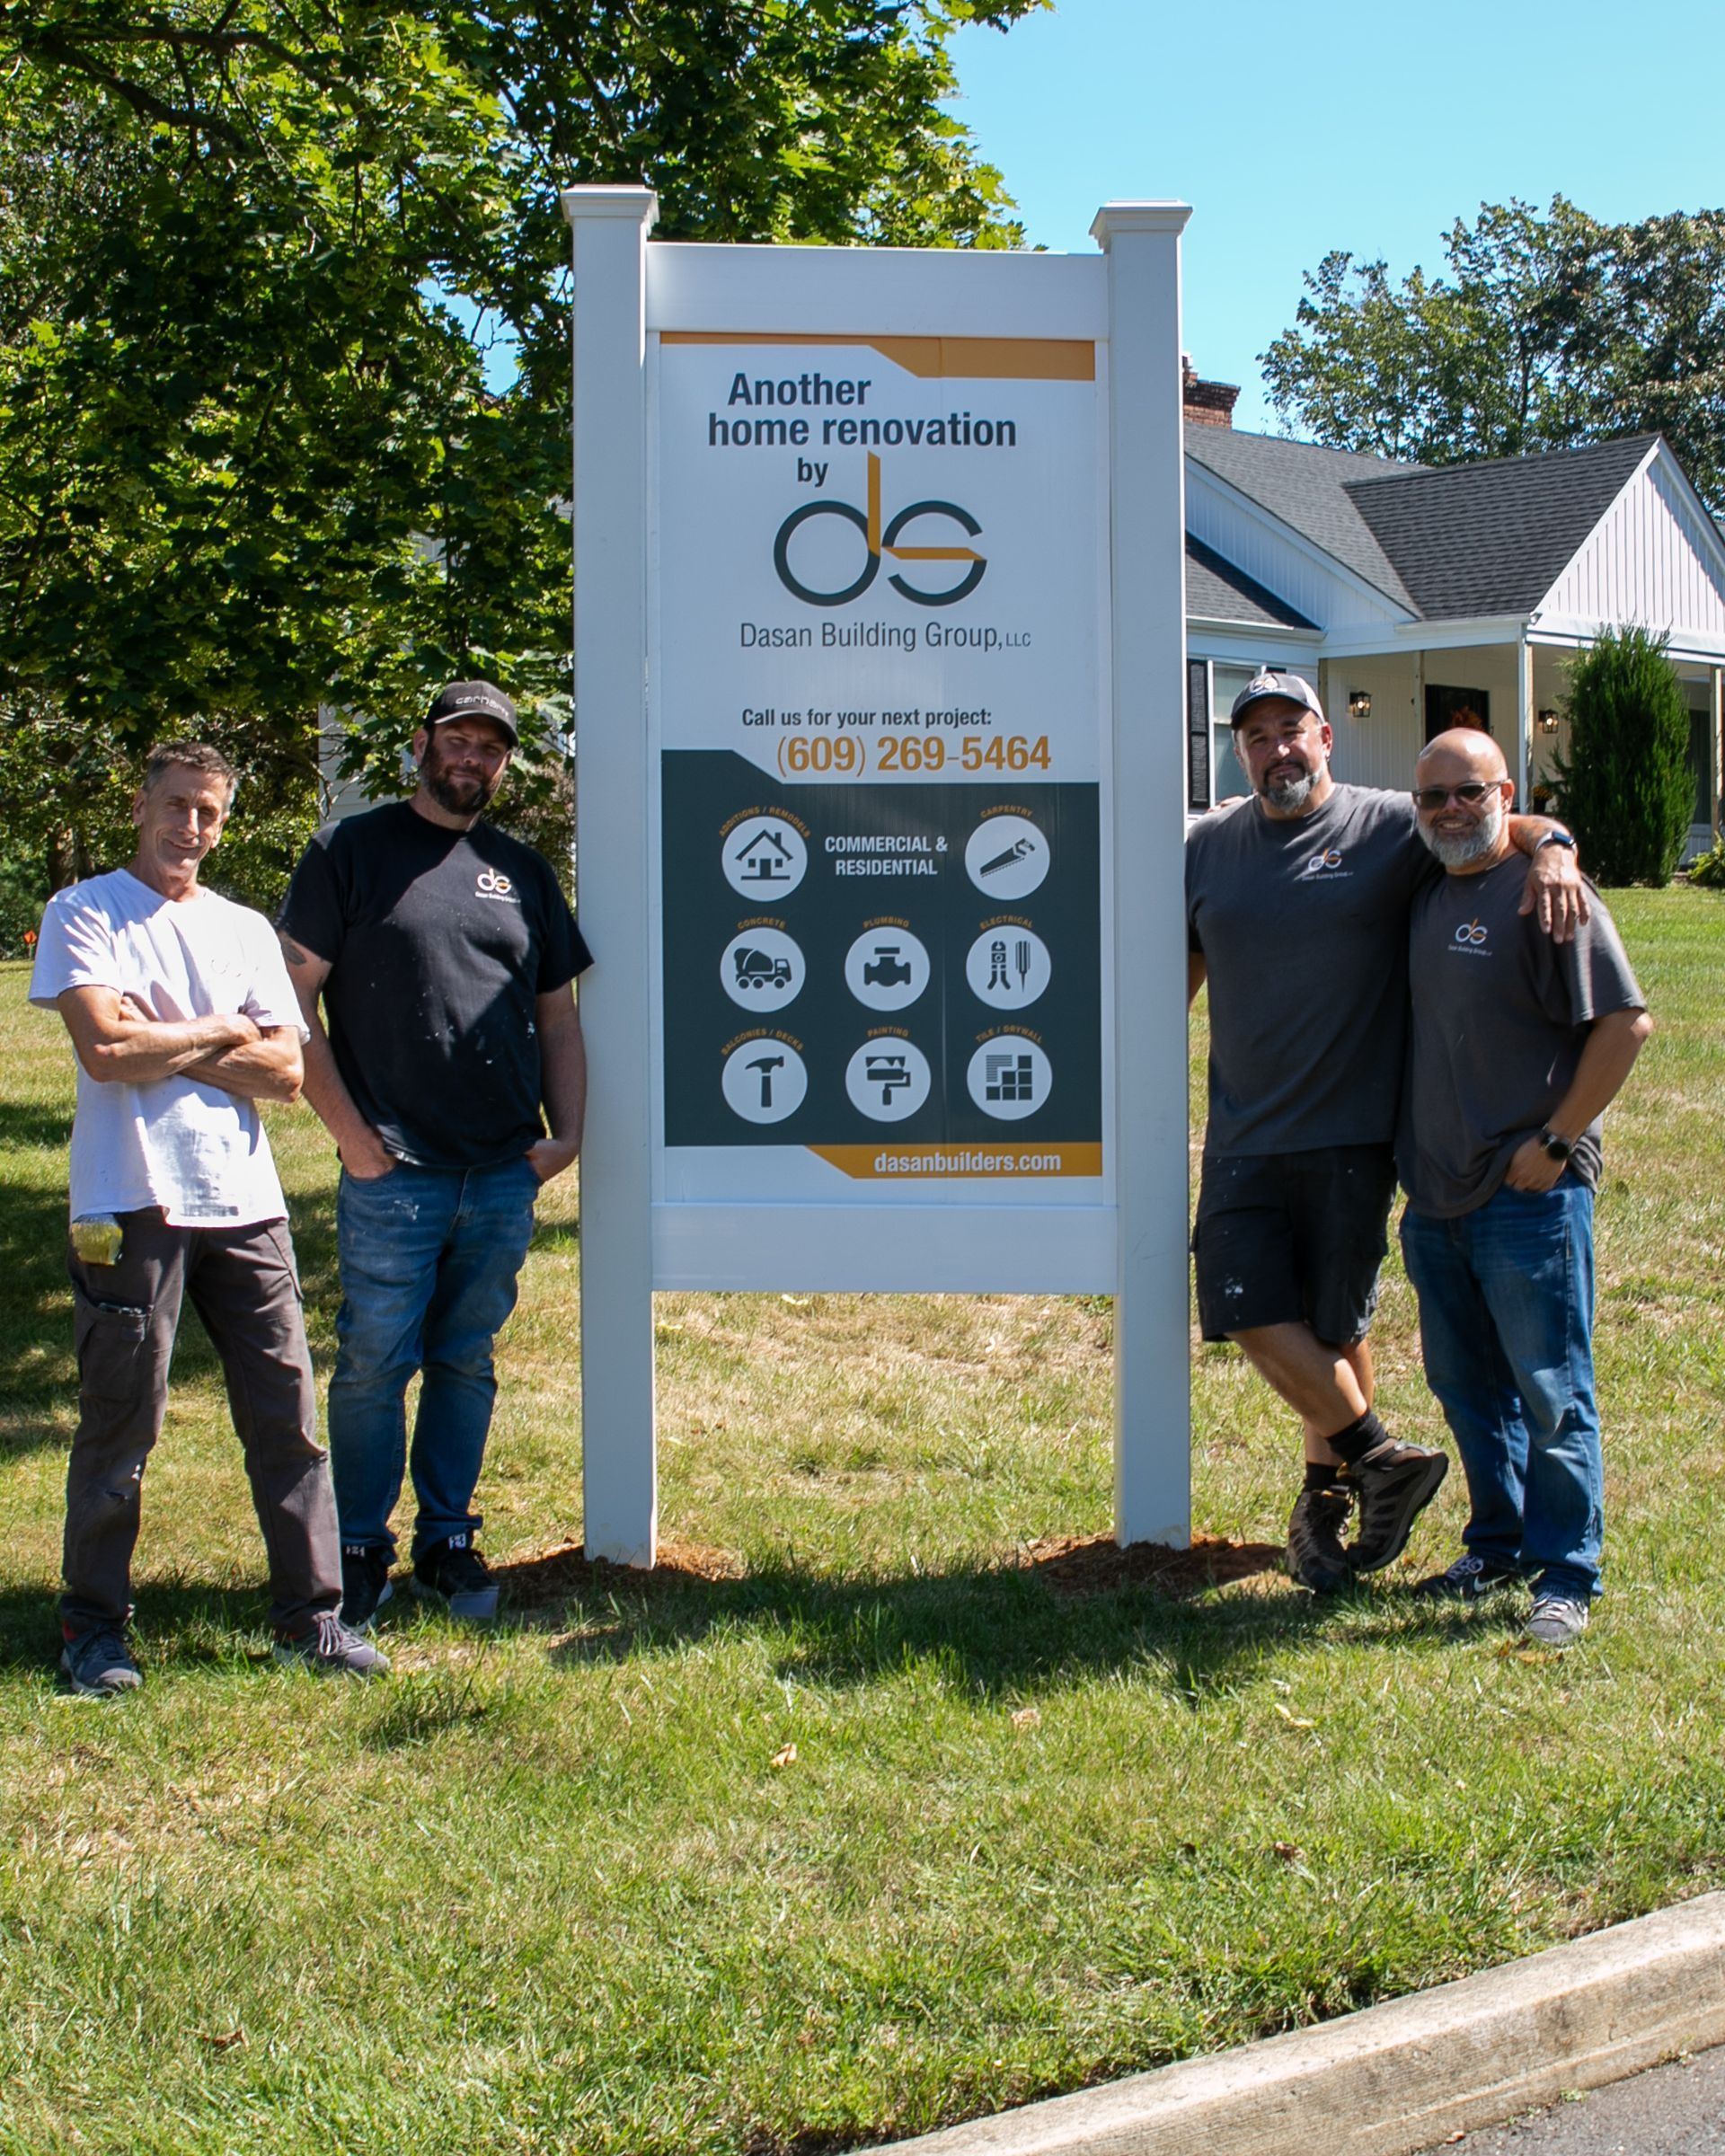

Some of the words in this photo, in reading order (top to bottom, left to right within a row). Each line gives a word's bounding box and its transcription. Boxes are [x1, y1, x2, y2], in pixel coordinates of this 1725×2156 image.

[728, 373, 871, 405] Another
[708, 412, 809, 446] home
[822, 411, 1017, 446] renovation
[797, 457, 828, 488] by
[740, 622, 812, 648] Dasan
[821, 622, 916, 652] Building
[741, 709, 775, 727] Call
[781, 711, 802, 726] us
[808, 708, 832, 726] for
[836, 711, 877, 729] your
[881, 710, 920, 726] next
[924, 708, 992, 729] project:
[777, 735, 866, 778] (609)
[877, 735, 1052, 772] 269-5464
[825, 835, 932, 853] COMMERCIAL
[935, 835, 949, 852] &
[836, 859, 938, 876] RESIDENTIAL
[737, 916, 786, 930] CONCRETE
[721, 1028, 767, 1055] BALCONIES
[775, 1029, 804, 1050] DECKS
[874, 1152, 1061, 1172] dasanbuilders.com
